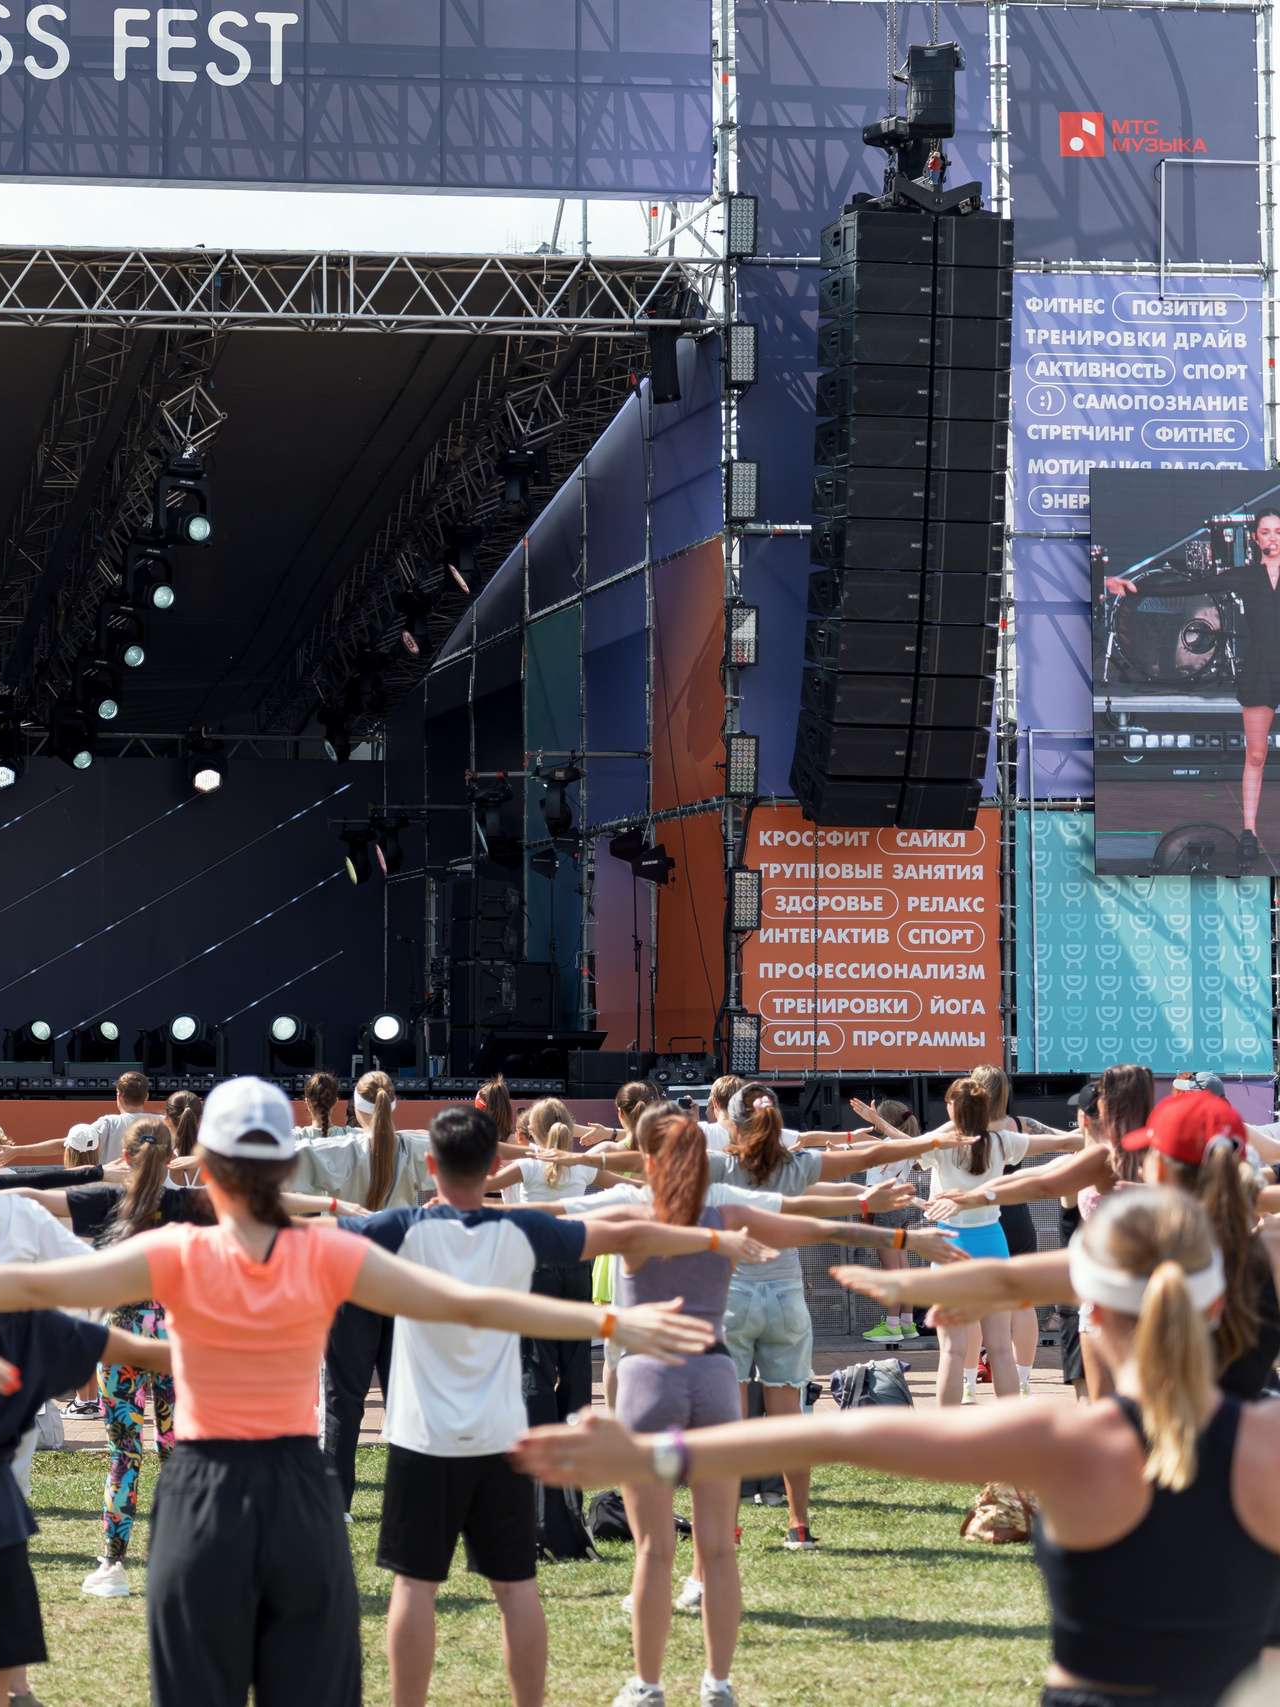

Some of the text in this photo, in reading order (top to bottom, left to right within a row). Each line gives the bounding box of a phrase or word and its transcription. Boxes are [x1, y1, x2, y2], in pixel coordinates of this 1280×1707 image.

[113, 7, 299, 87] FEST
[1112, 119, 1159, 135] МТС
[1112, 137, 1207, 153] МУЗЫКА
[1025, 296, 1228, 317] ФИТНЕС ПОЗИТИВ
[1025, 328, 1248, 351] ТРЕНИРОВКИ ДРАЙВ
[1034, 361, 1248, 381] АКТИВНОСТЬ СПОРТ
[1072, 392, 1249, 412] САМОПОЗНАНИЕ
[1026, 423, 1236, 443] СТРЕТЧИНГ ФИТНЕС
[759, 829, 966, 848] КРОССФИТ САЙКЛ
[760, 862, 984, 881] ГРУППОВЫЕ ЗАНЯТИЯ
[774, 895, 985, 914] ЗДОРОВЬЕ РЕЛАКС
[759, 927, 975, 945] ИНТЕРАКТИВ СПОРТ
[759, 962, 986, 980] ПРОФЕССИОНАЛИЗМ
[772, 995, 986, 1015] ТРЕНИРОВКИ ЙОГА
[773, 1030, 986, 1047] СИЛА ПРОГРАММЫ
